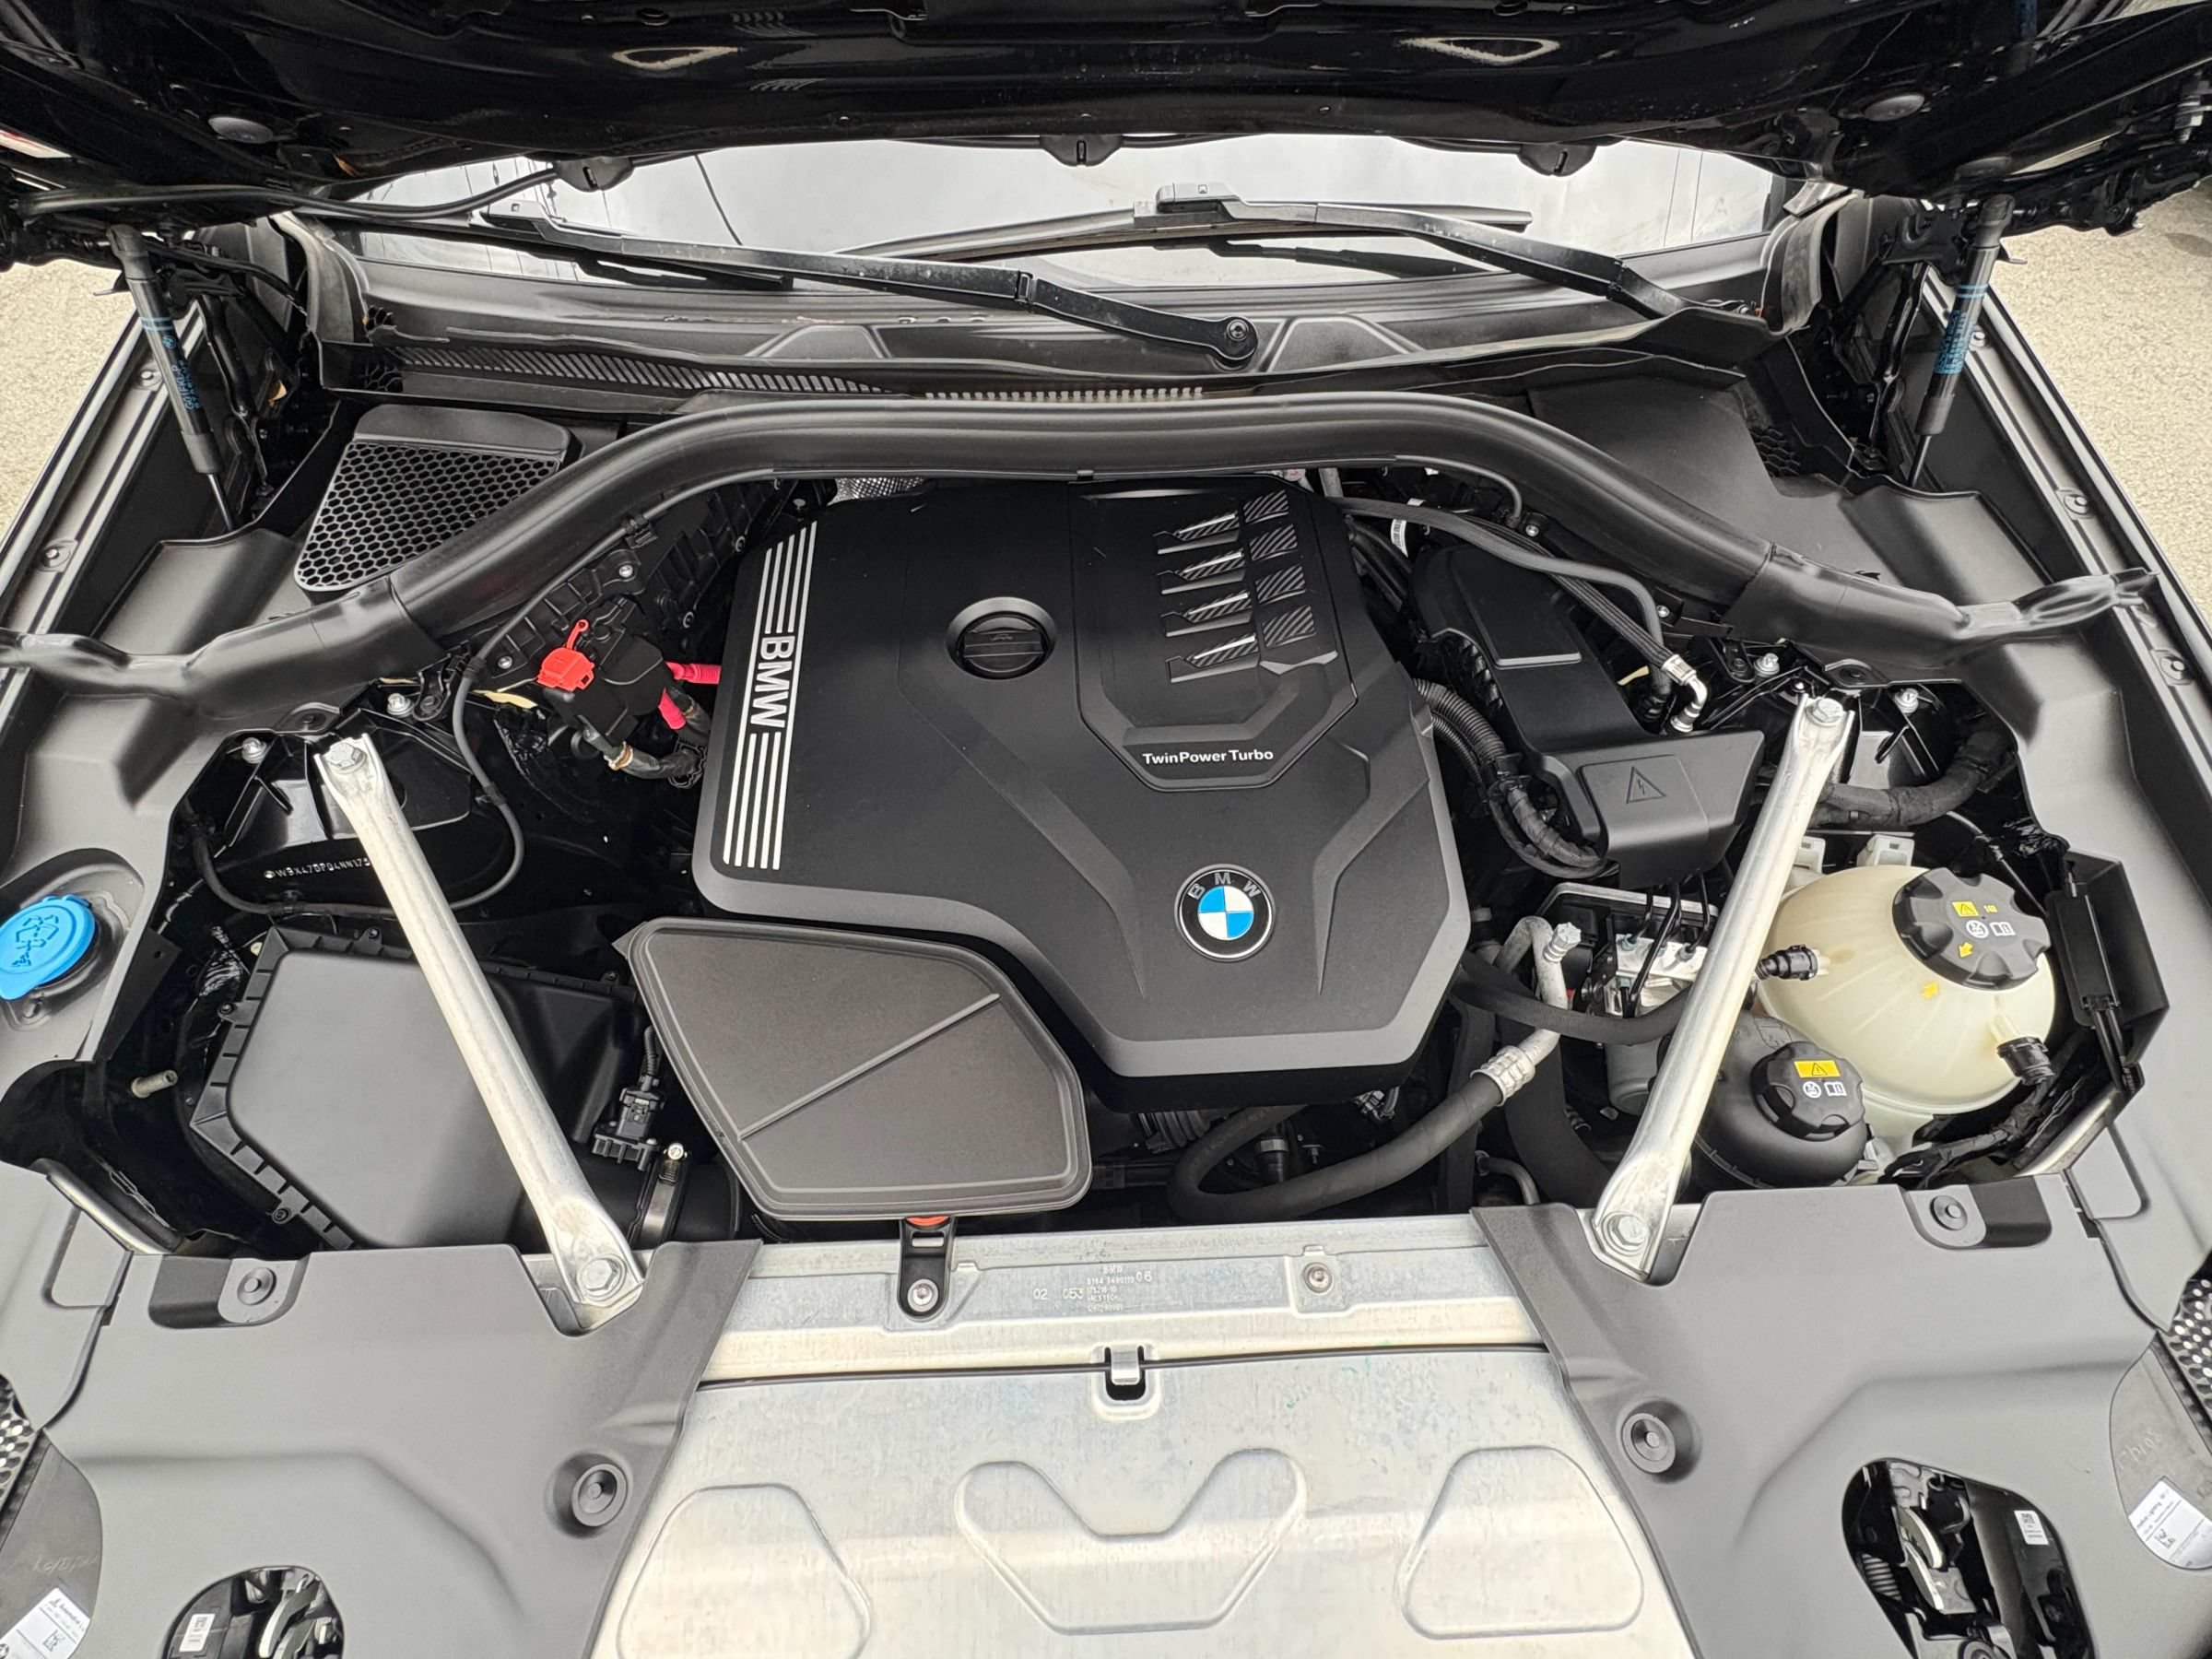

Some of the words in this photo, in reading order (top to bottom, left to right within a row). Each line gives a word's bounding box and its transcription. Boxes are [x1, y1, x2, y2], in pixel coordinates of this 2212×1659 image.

[750, 635, 795, 728] BMW
[1142, 751, 1227, 765] TwinPower
[1229, 748, 1274, 761] Turbo
[1187, 872, 1262, 900] BMW
[1135, 1271, 1152, 1282] 06
[1033, 1288, 1048, 1300] 02
